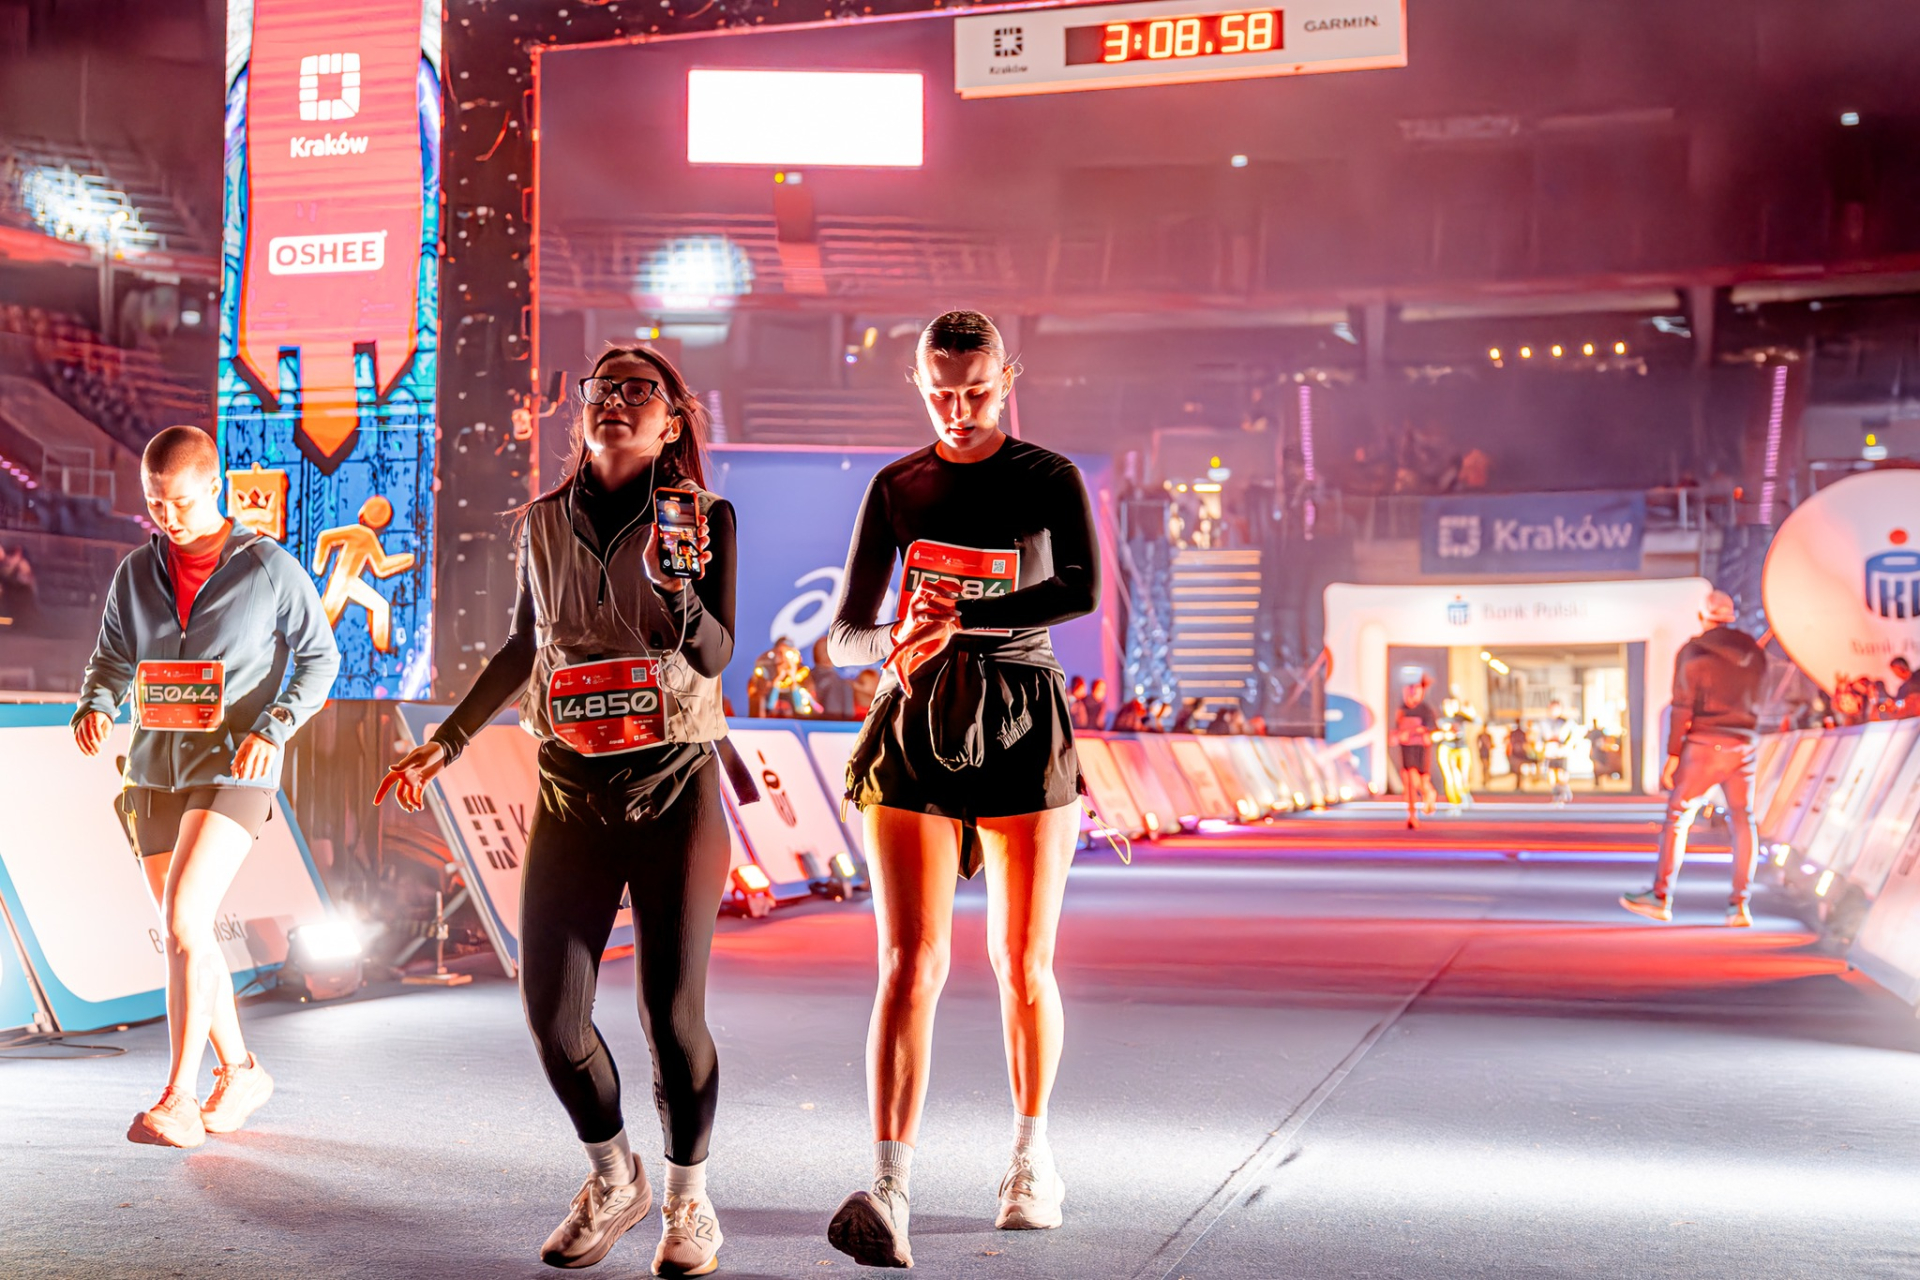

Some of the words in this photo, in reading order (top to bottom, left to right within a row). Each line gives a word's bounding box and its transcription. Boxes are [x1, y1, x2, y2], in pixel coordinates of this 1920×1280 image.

[1104, 12, 1273, 63] 3:08.58
[1303, 15, 1379, 33] GARMIN
[290, 132, 369, 158] Kraków
[275, 240, 377, 267] OSHEE
[1494, 514, 1633, 550] Kraków
[141, 685, 219, 703] 15044
[551, 690, 659, 721] 14850
